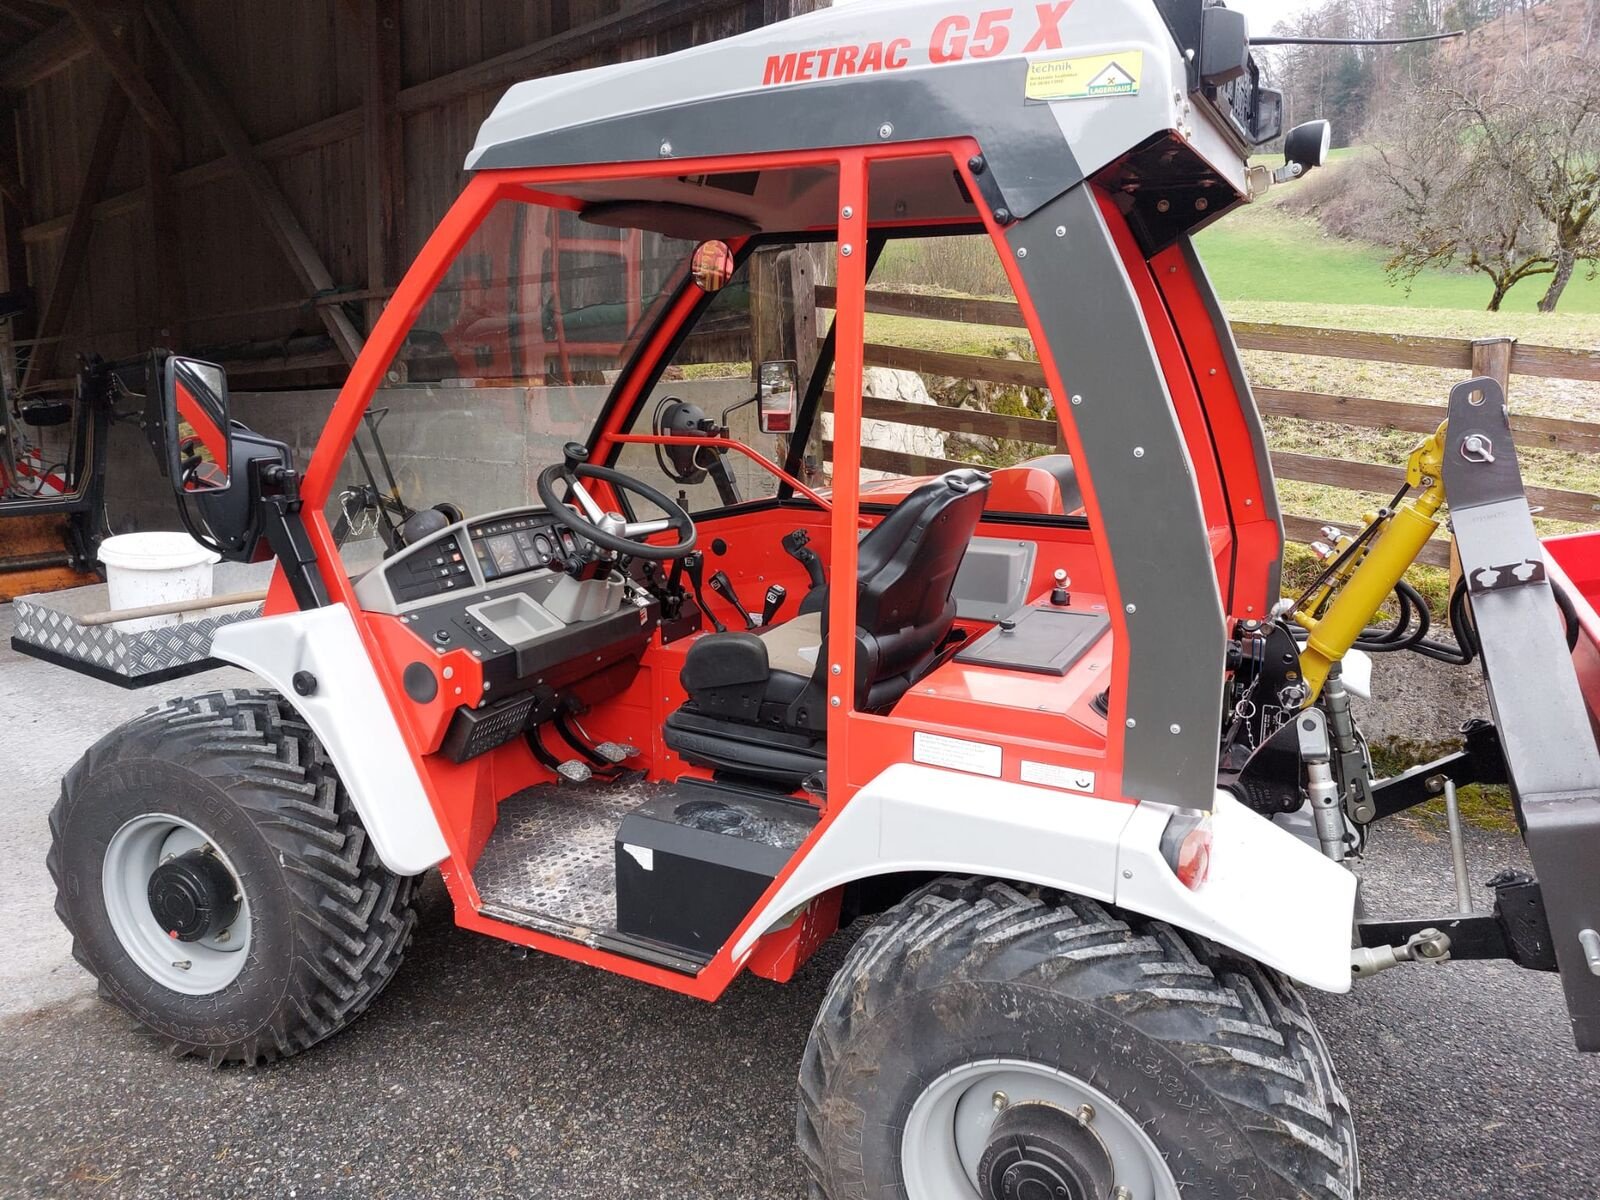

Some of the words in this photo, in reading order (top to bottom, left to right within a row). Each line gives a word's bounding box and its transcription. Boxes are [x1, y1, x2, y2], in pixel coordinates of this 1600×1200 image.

[762, 38, 911, 86] METRAC
[928, 8, 1013, 64] G5
[1023, 0, 1073, 52] X
[1032, 62, 1072, 73] technik
[1091, 86, 1131, 95] LAGERHAUS
